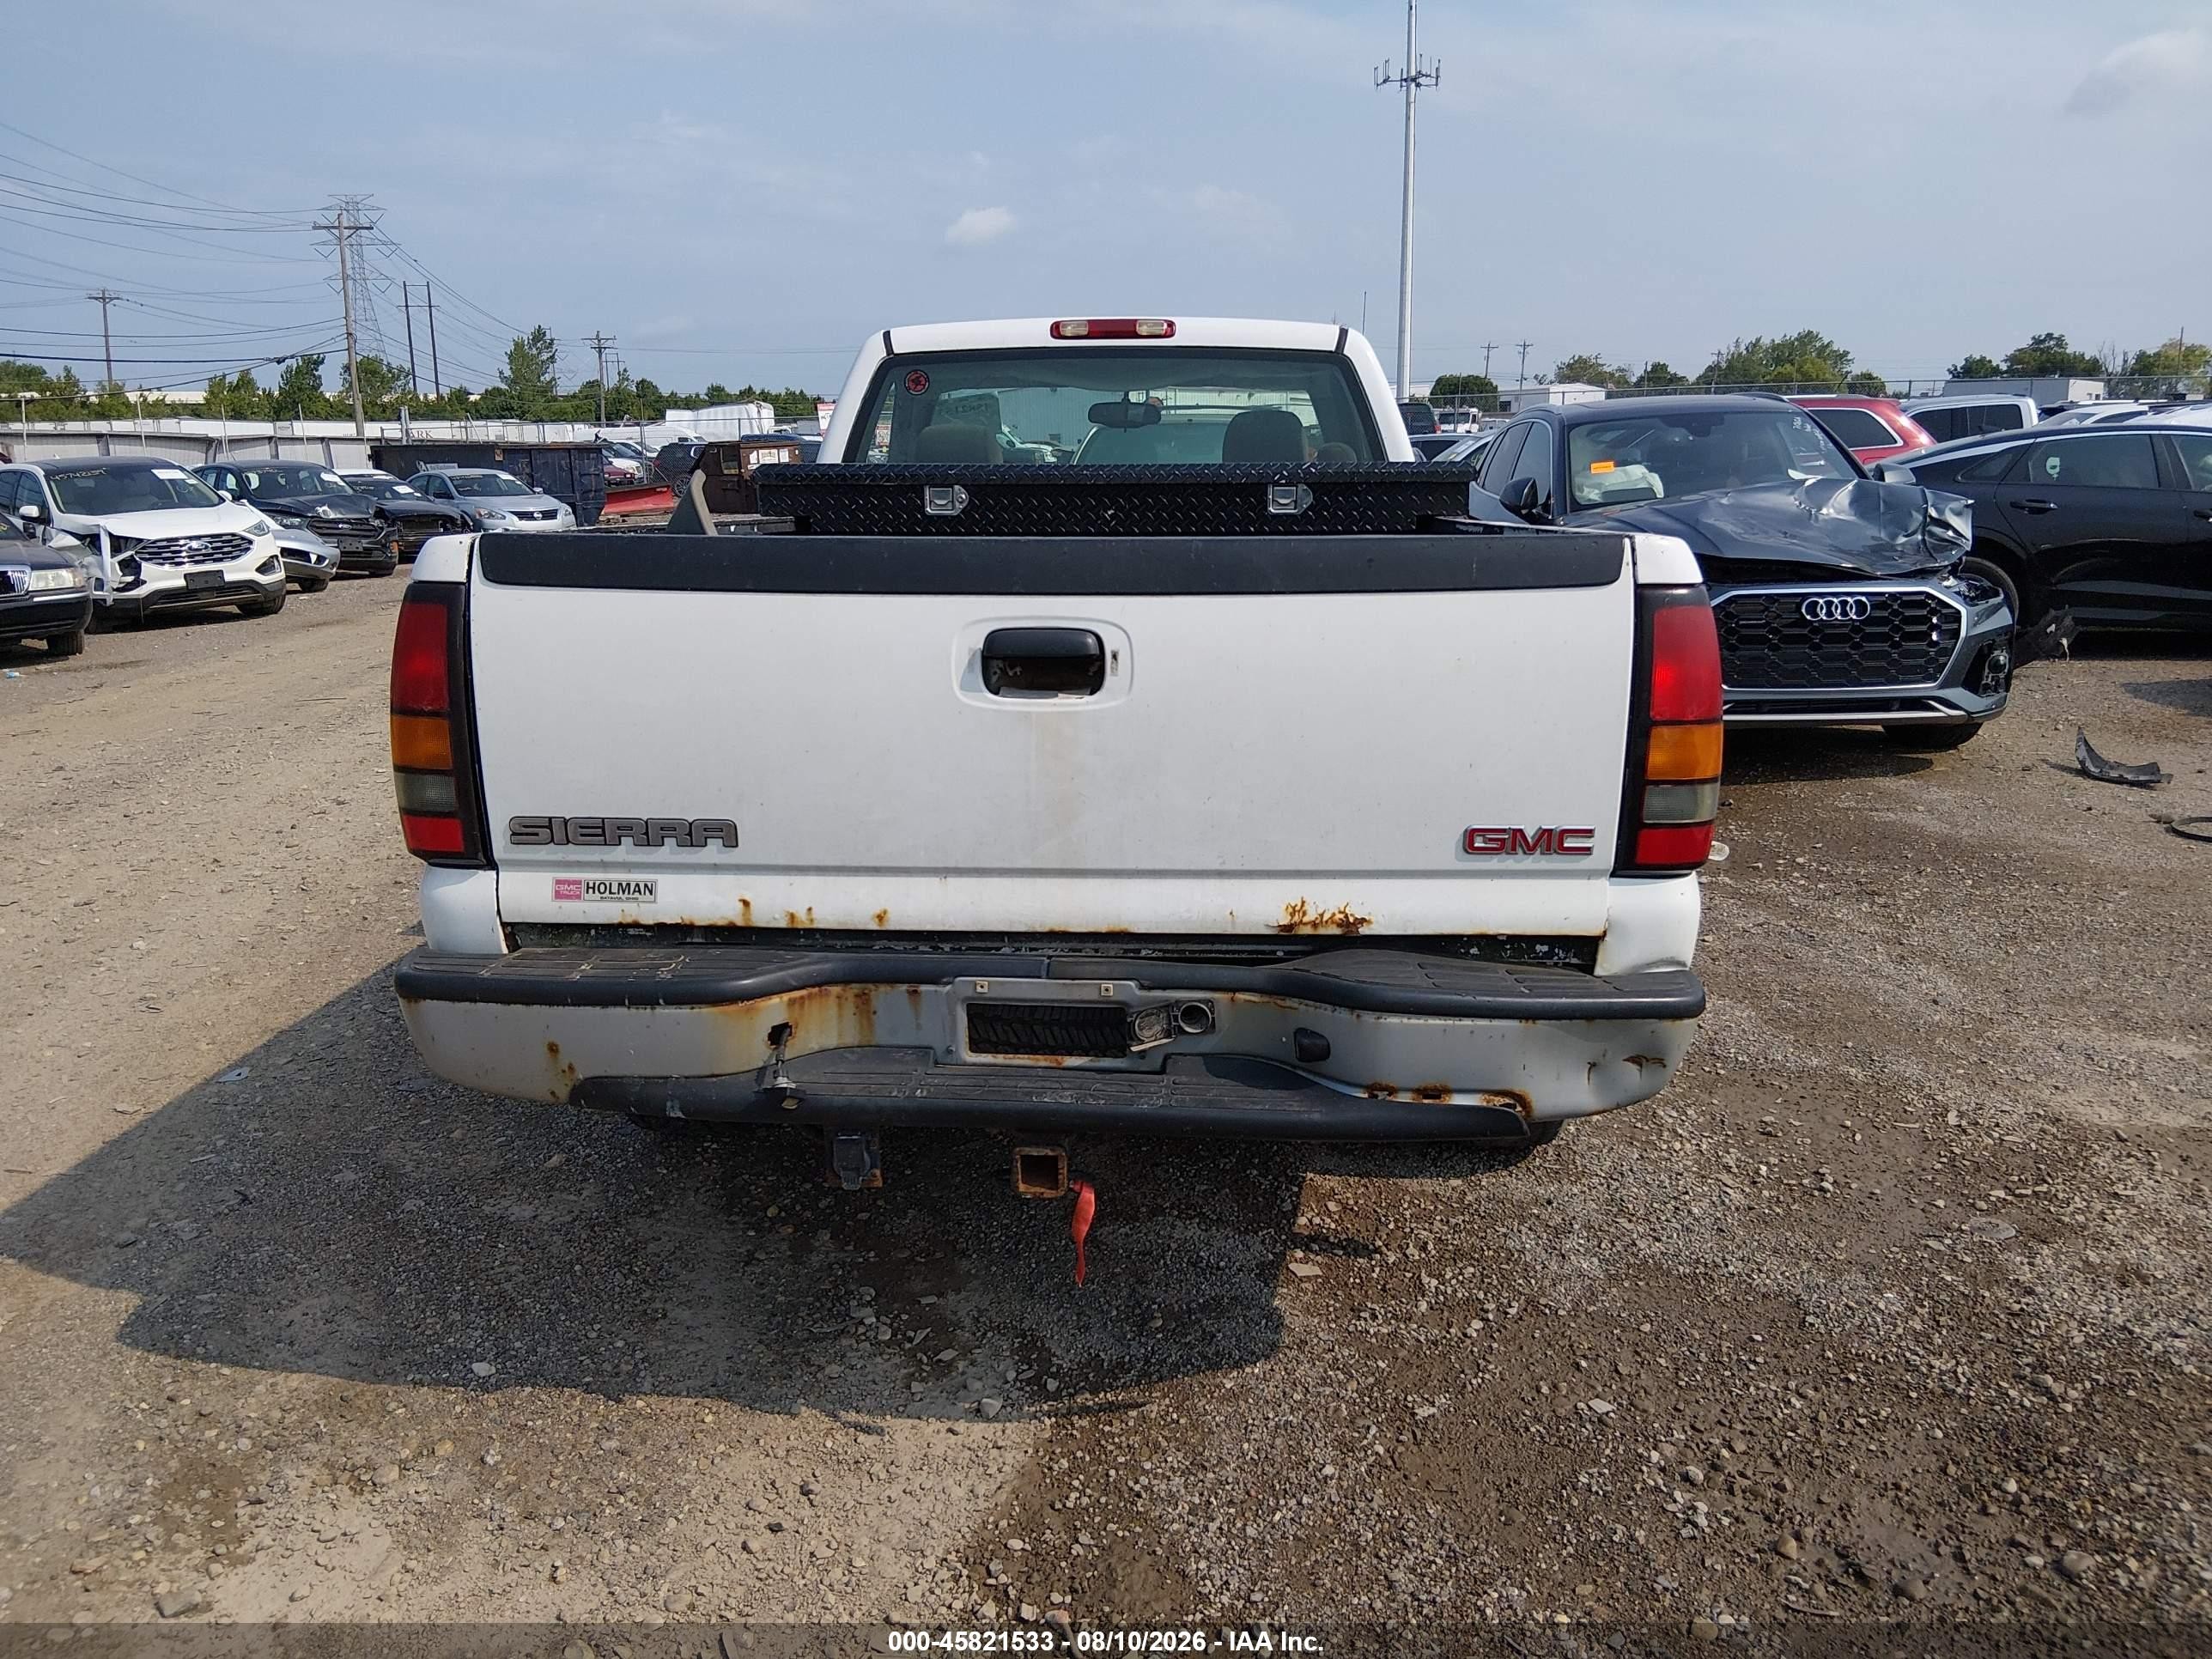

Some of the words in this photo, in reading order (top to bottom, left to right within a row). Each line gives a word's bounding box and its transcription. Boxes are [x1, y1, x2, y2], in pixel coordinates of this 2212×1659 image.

[509, 816, 738, 848] SIERRA
[1463, 824, 1595, 855] GMC
[586, 881, 653, 896] HOLMAN
